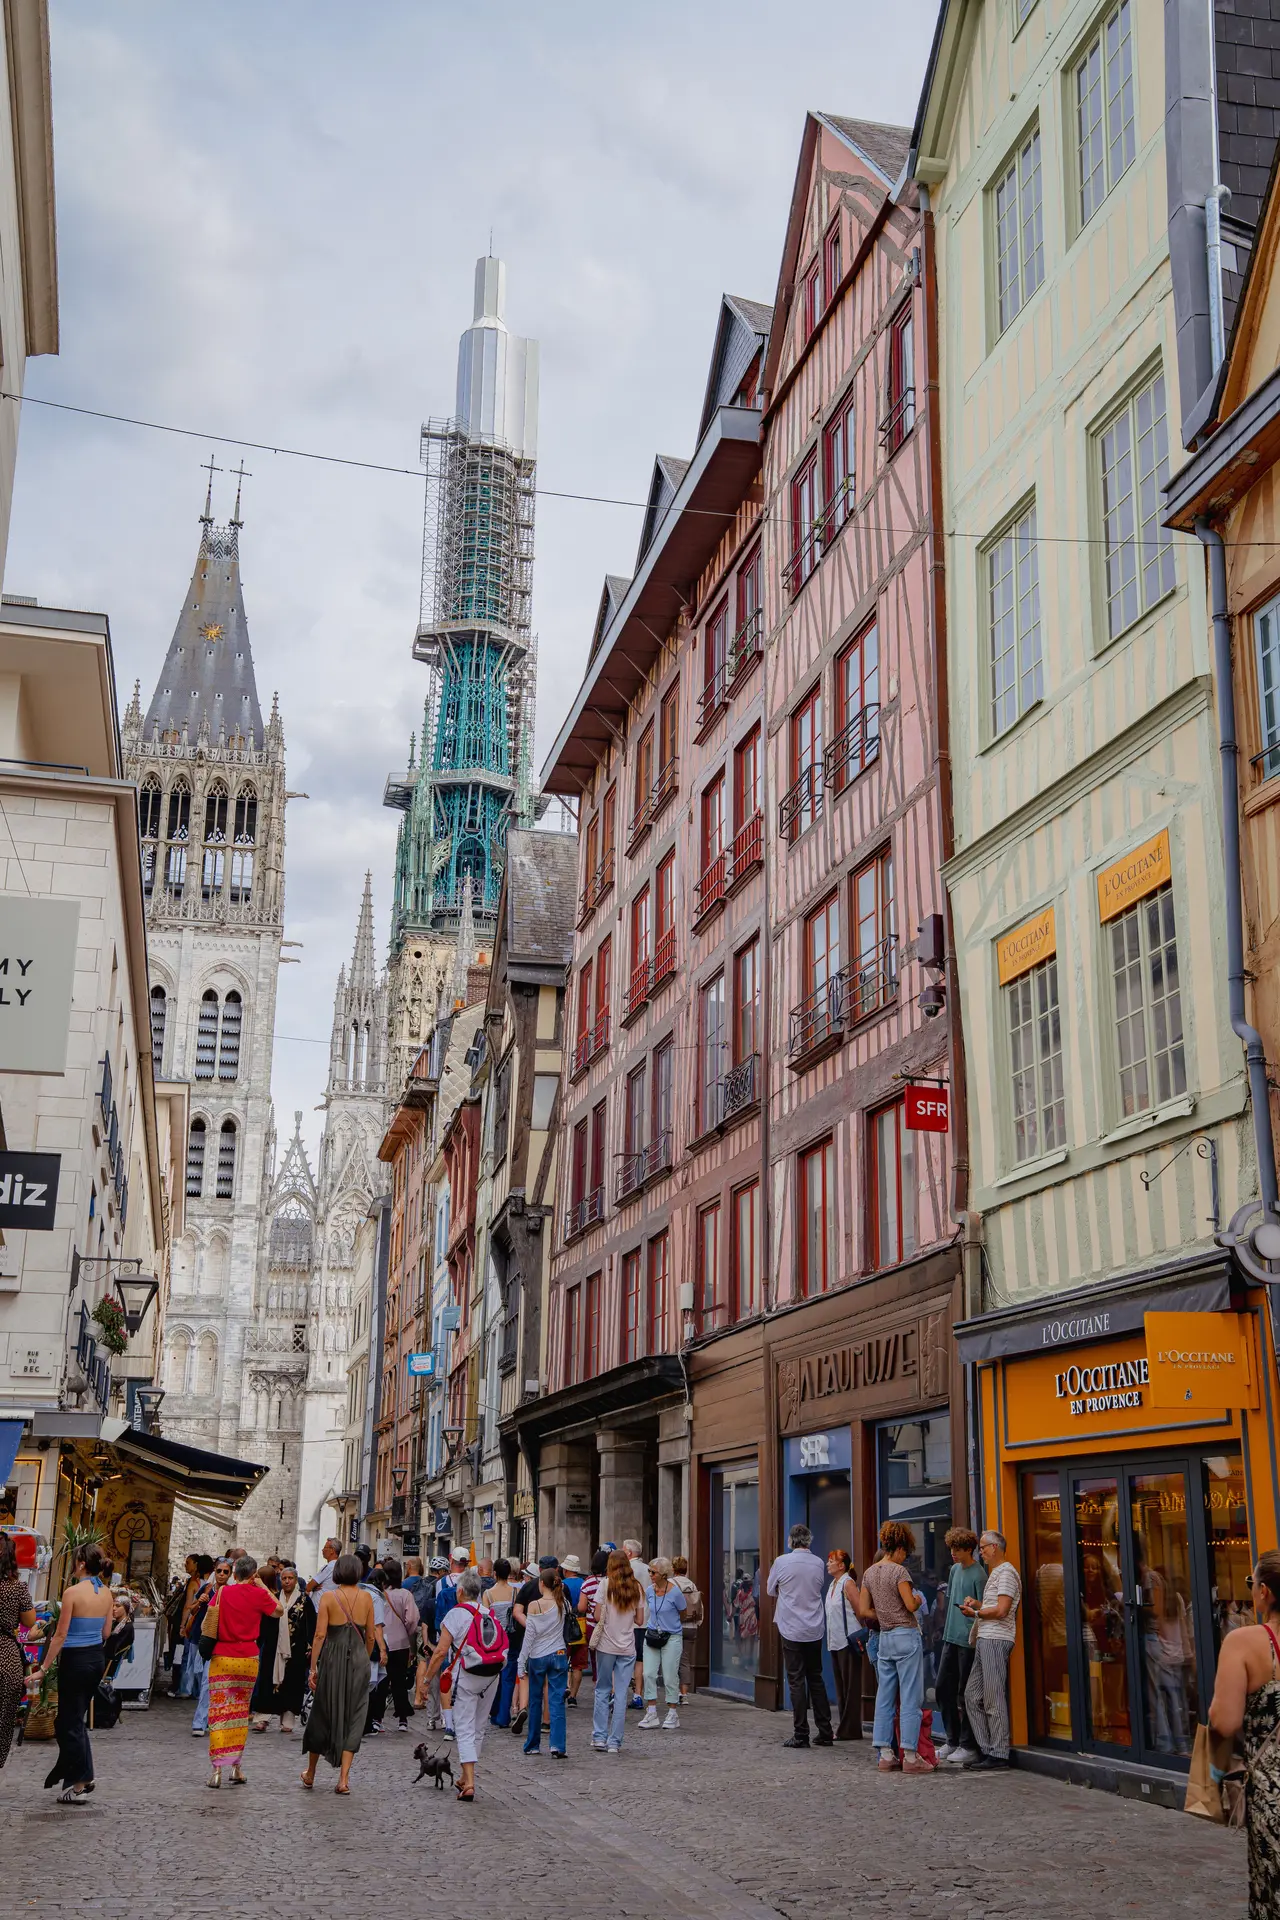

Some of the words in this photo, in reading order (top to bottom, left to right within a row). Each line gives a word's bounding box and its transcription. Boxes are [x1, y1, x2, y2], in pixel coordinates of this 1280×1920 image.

[1104, 846, 1163, 897] L'OCCITANE
[1116, 891, 1124, 900] EN
[1125, 872, 1152, 893] PROVENCE
[1003, 921, 1050, 963] L'OCCITANE
[916, 1100, 948, 1117] SFR
[1042, 1313, 1110, 1344] L'OCCITANE
[23, 1365, 40, 1373] BEC
[1157, 1349, 1236, 1363] L'OCCITANE
[1055, 1358, 1150, 1398] L'OCCITANE
[1070, 1400, 1083, 1415] EN
[1086, 1391, 1141, 1412] PROVENCE
[800, 1434, 830, 1468] SFR
